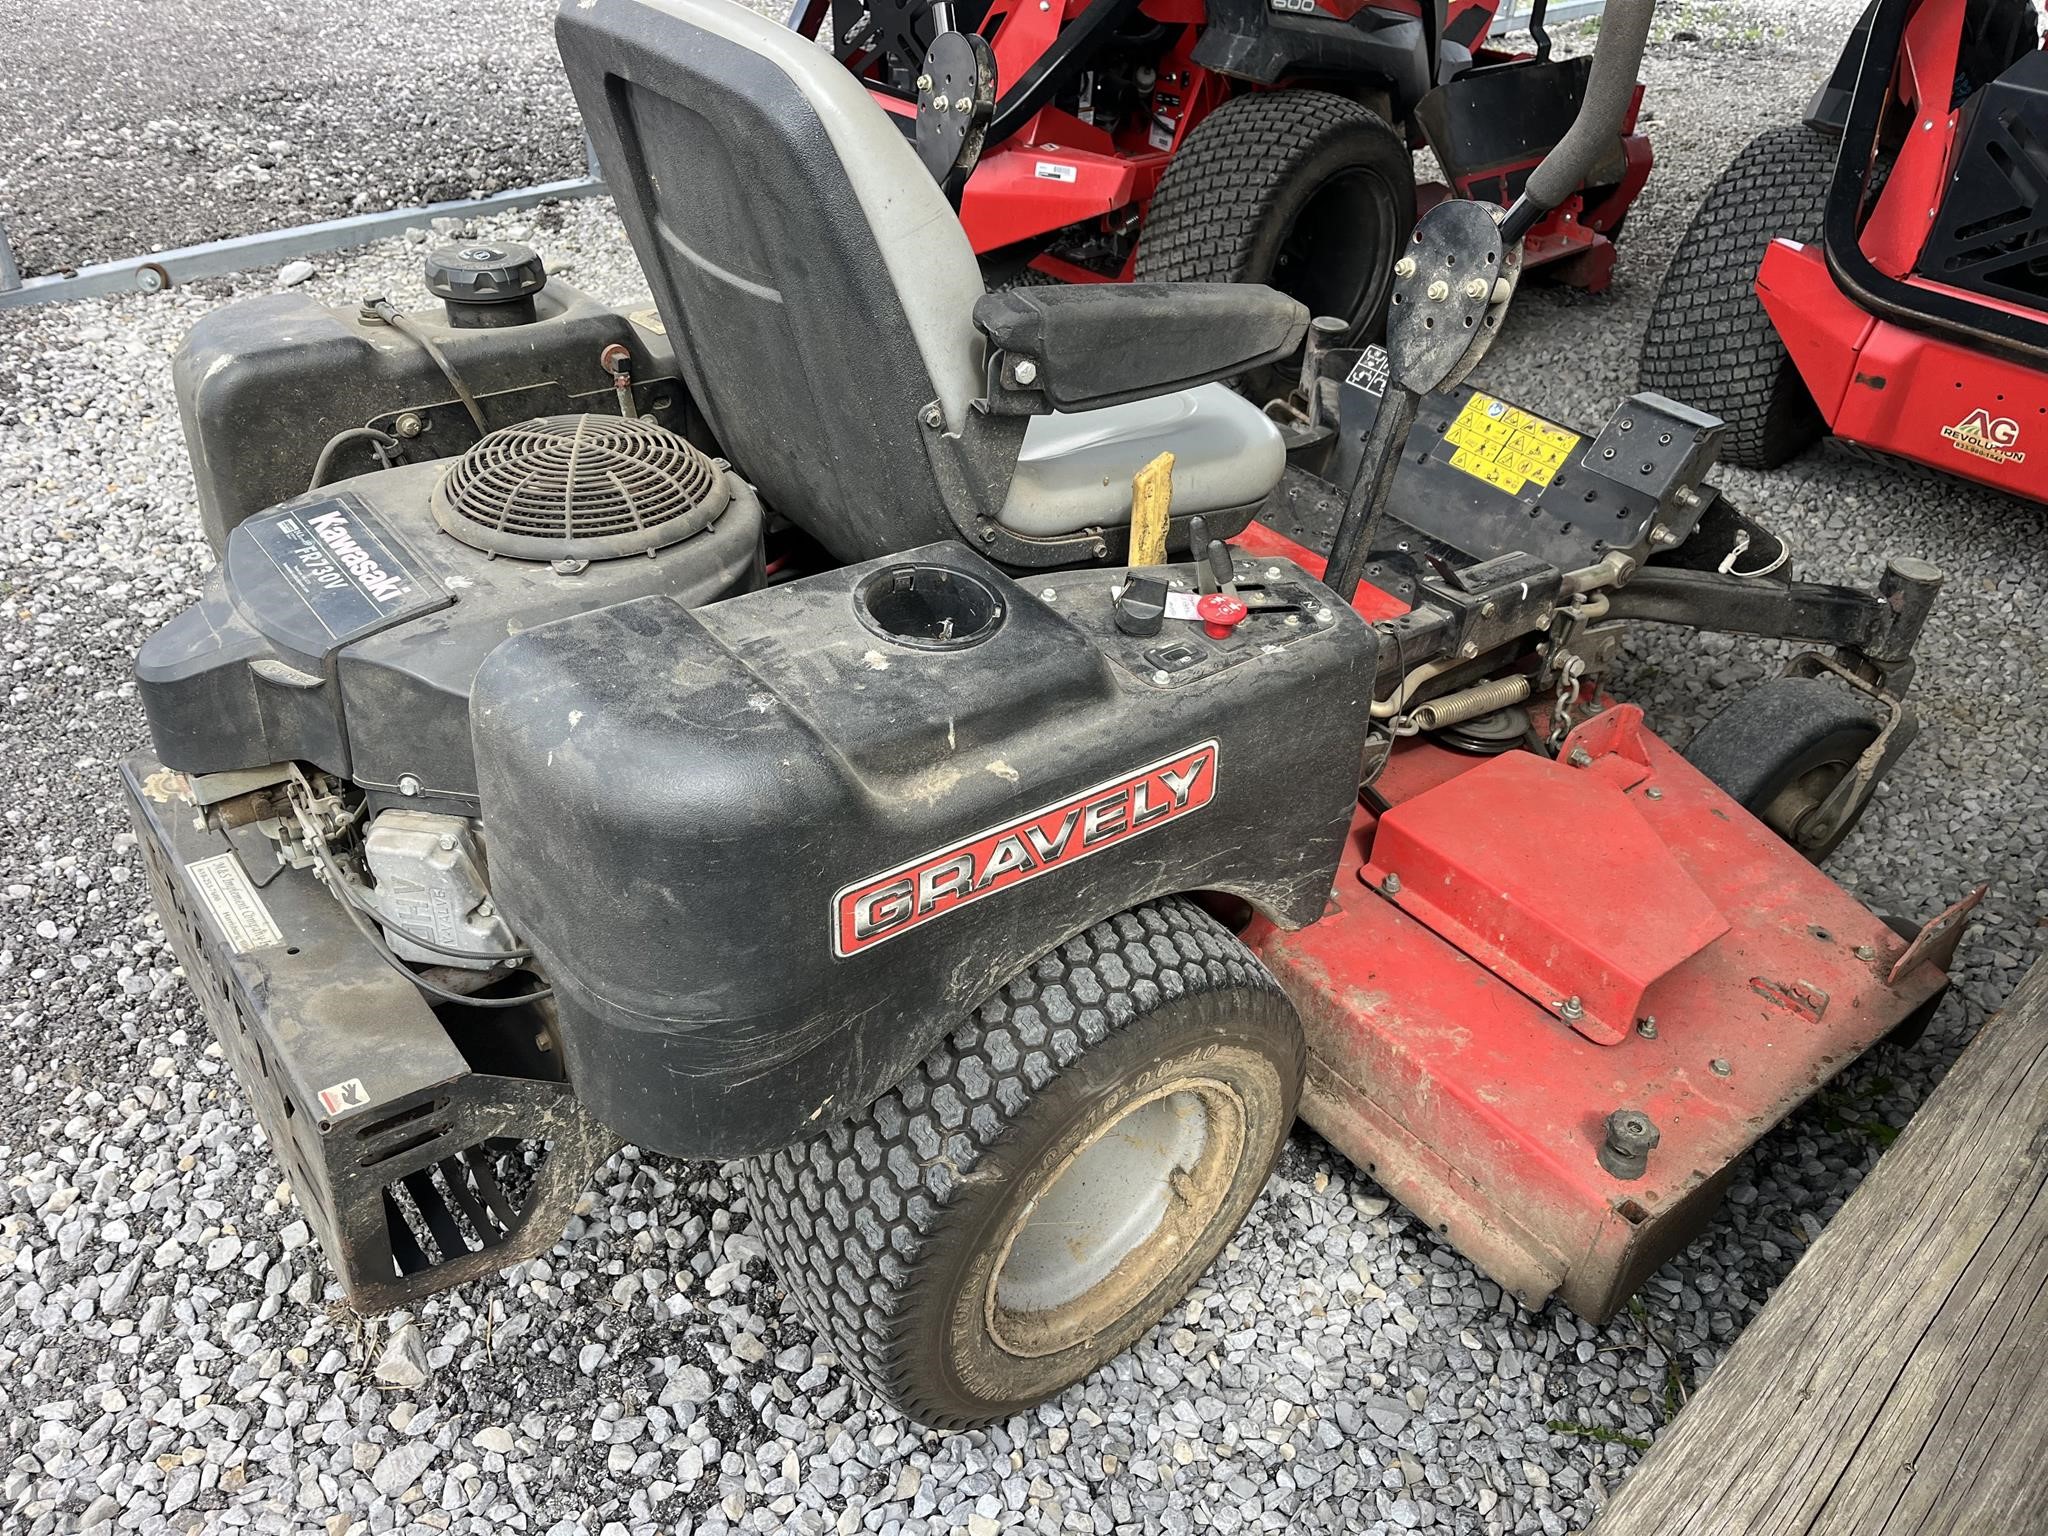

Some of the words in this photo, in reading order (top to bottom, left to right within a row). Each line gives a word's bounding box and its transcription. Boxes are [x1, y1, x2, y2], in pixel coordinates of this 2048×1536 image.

[1961, 411, 2016, 444] AG
[294, 544, 349, 589] FR730V
[308, 510, 411, 602] Kawasaki
[854, 754, 1210, 940] GRAVELY
